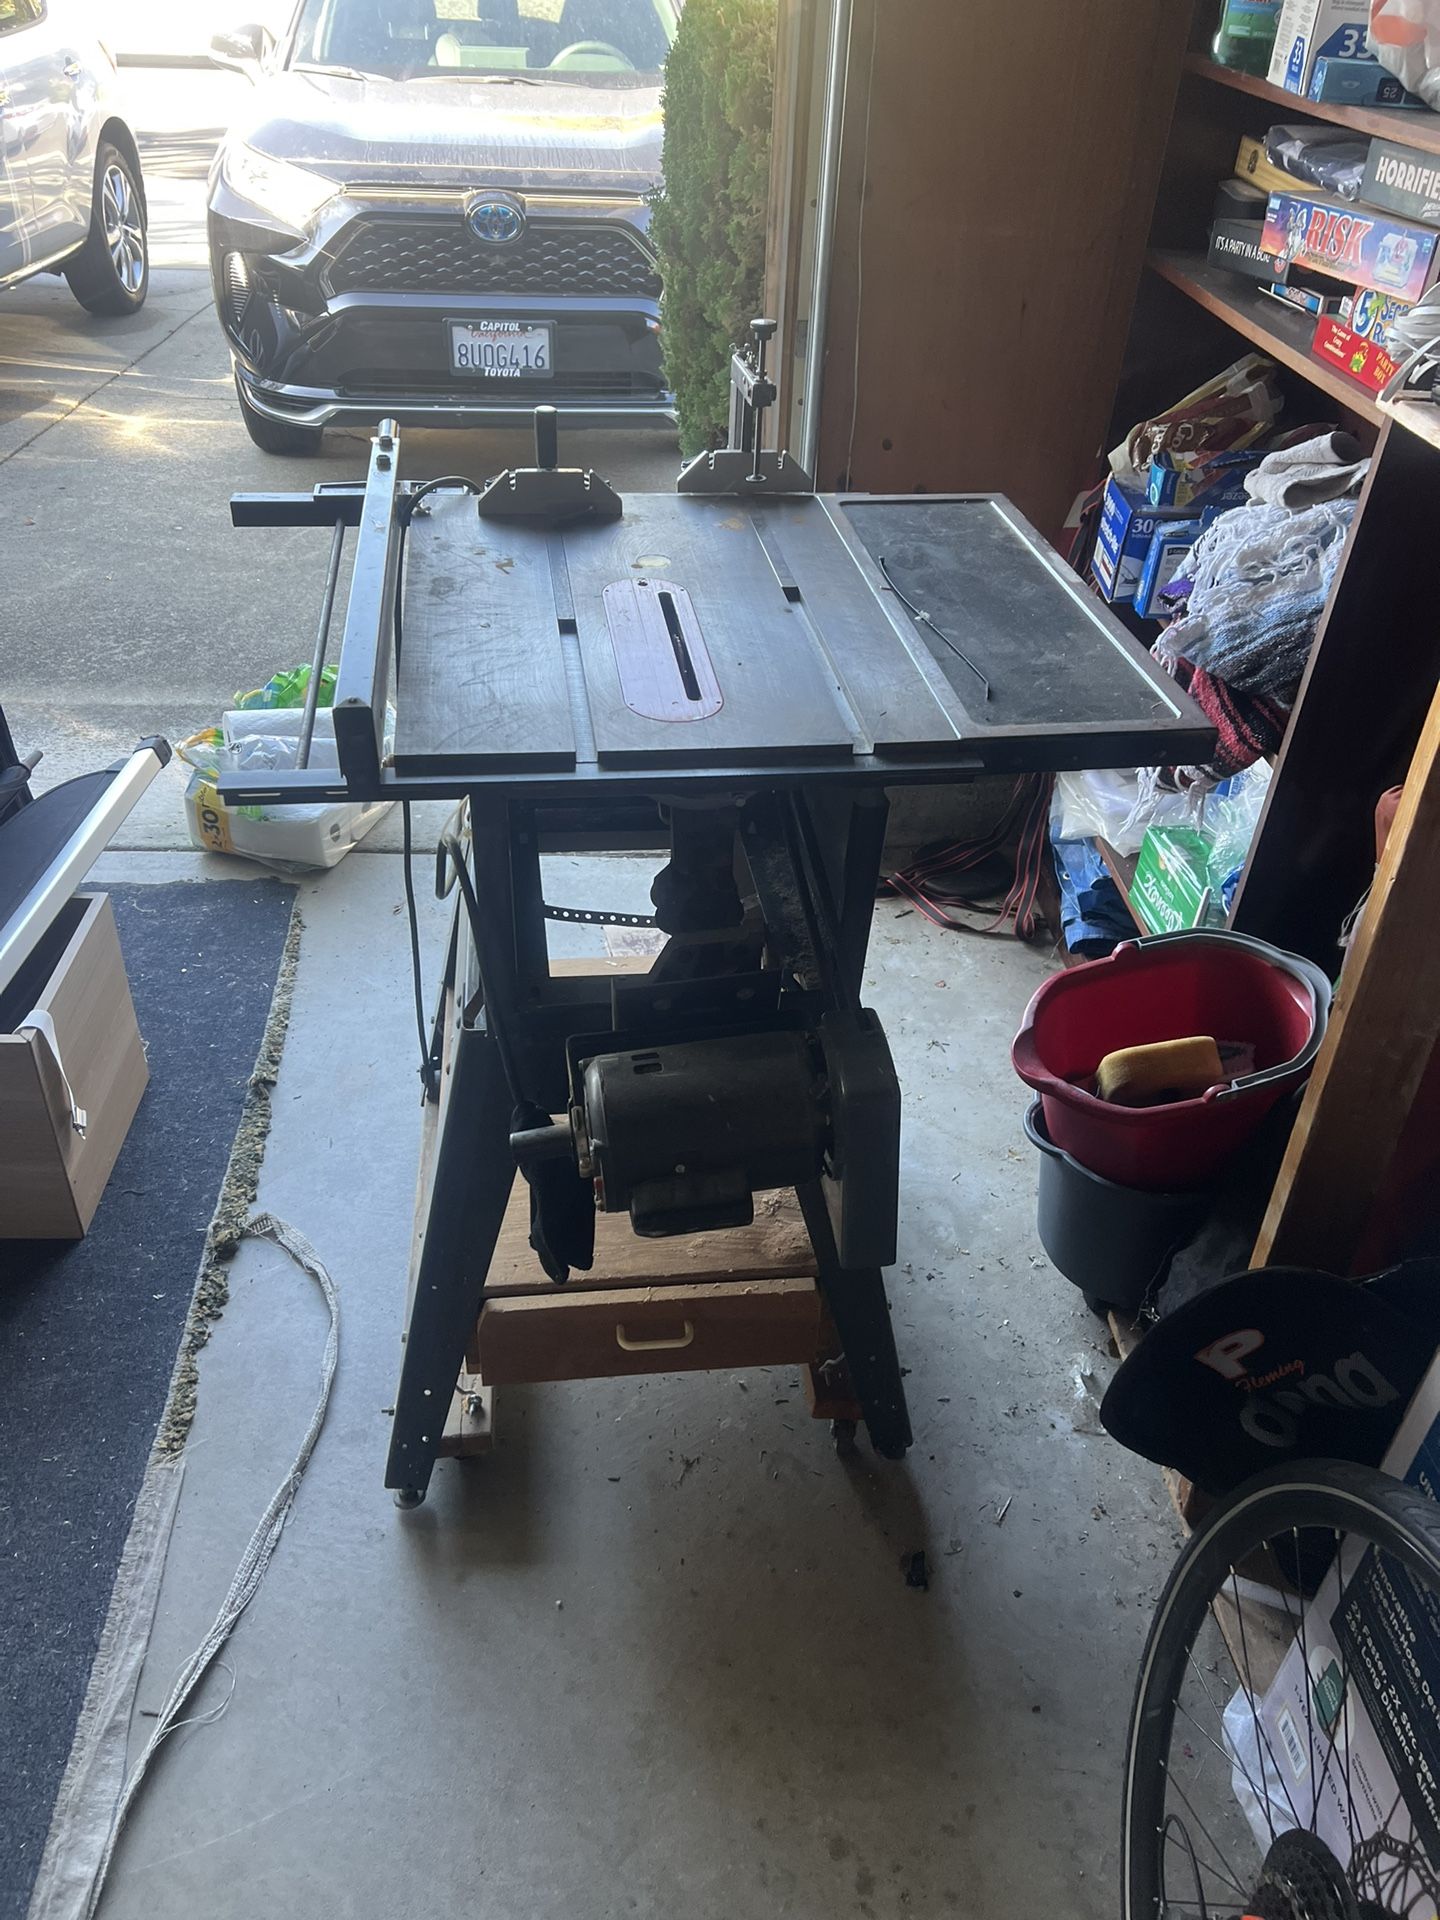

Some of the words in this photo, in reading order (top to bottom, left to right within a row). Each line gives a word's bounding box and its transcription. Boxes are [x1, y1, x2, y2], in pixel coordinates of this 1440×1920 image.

[1375, 156, 1440, 201] HORRIFIE
[1228, 239, 1248, 256] PARTY
[1244, 243, 1254, 257] IN
[1251, 245, 1259, 259] A
[1305, 207, 1374, 265] RISK
[480, 321, 520, 331] CAPITOL
[1354, 292, 1374, 333] 5
[484, 367, 521, 377] TOYOTA
[1373, 366, 1388, 385] BOX
[1376, 352, 1395, 377] PARTY
[1194, 1328, 1265, 1379] P
[1234, 1358, 1305, 1392] Fleming
[1361, 1625, 1388, 1685] Faster,
[1387, 1685, 1402, 1710] 2X
[1361, 1646, 1382, 1691] Long
[1379, 1691, 1416, 1766] Distance
